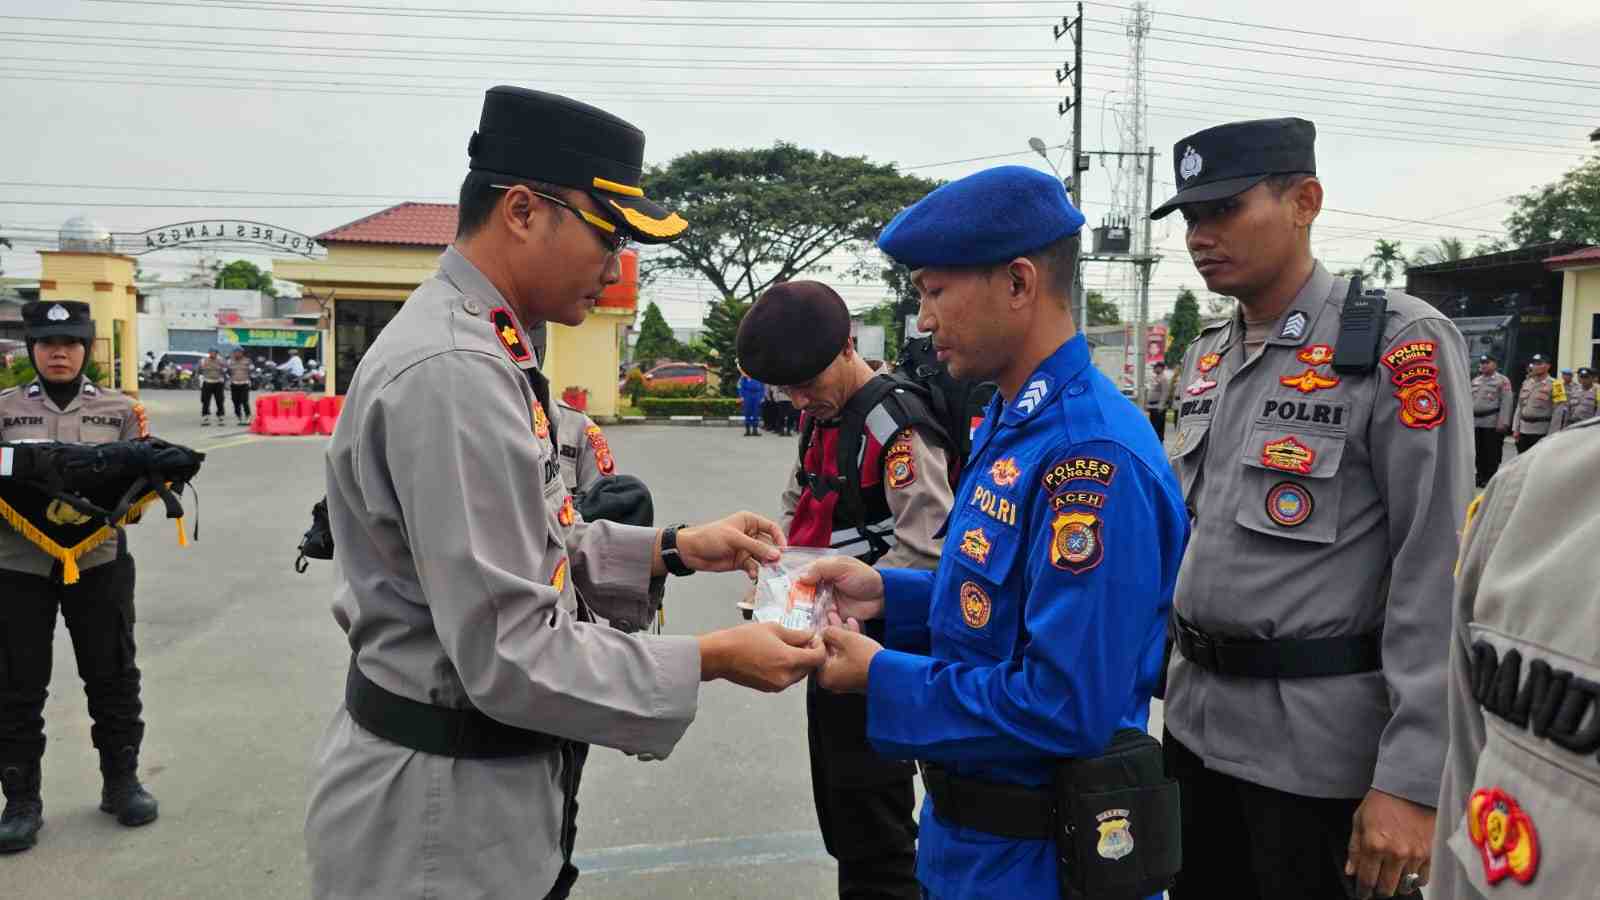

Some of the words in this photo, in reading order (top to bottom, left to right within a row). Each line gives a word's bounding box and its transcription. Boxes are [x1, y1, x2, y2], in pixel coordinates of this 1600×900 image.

[1387, 343, 1433, 364] POLRES
[3, 416, 43, 427] RATIH
[82, 415, 121, 427] POLRI
[1263, 400, 1343, 425] POLRI
[1046, 459, 1110, 484] POLRES
[1055, 469, 1100, 485] LANGSA
[970, 486, 1017, 526] POLRI
[1056, 493, 1099, 508] ACEH
